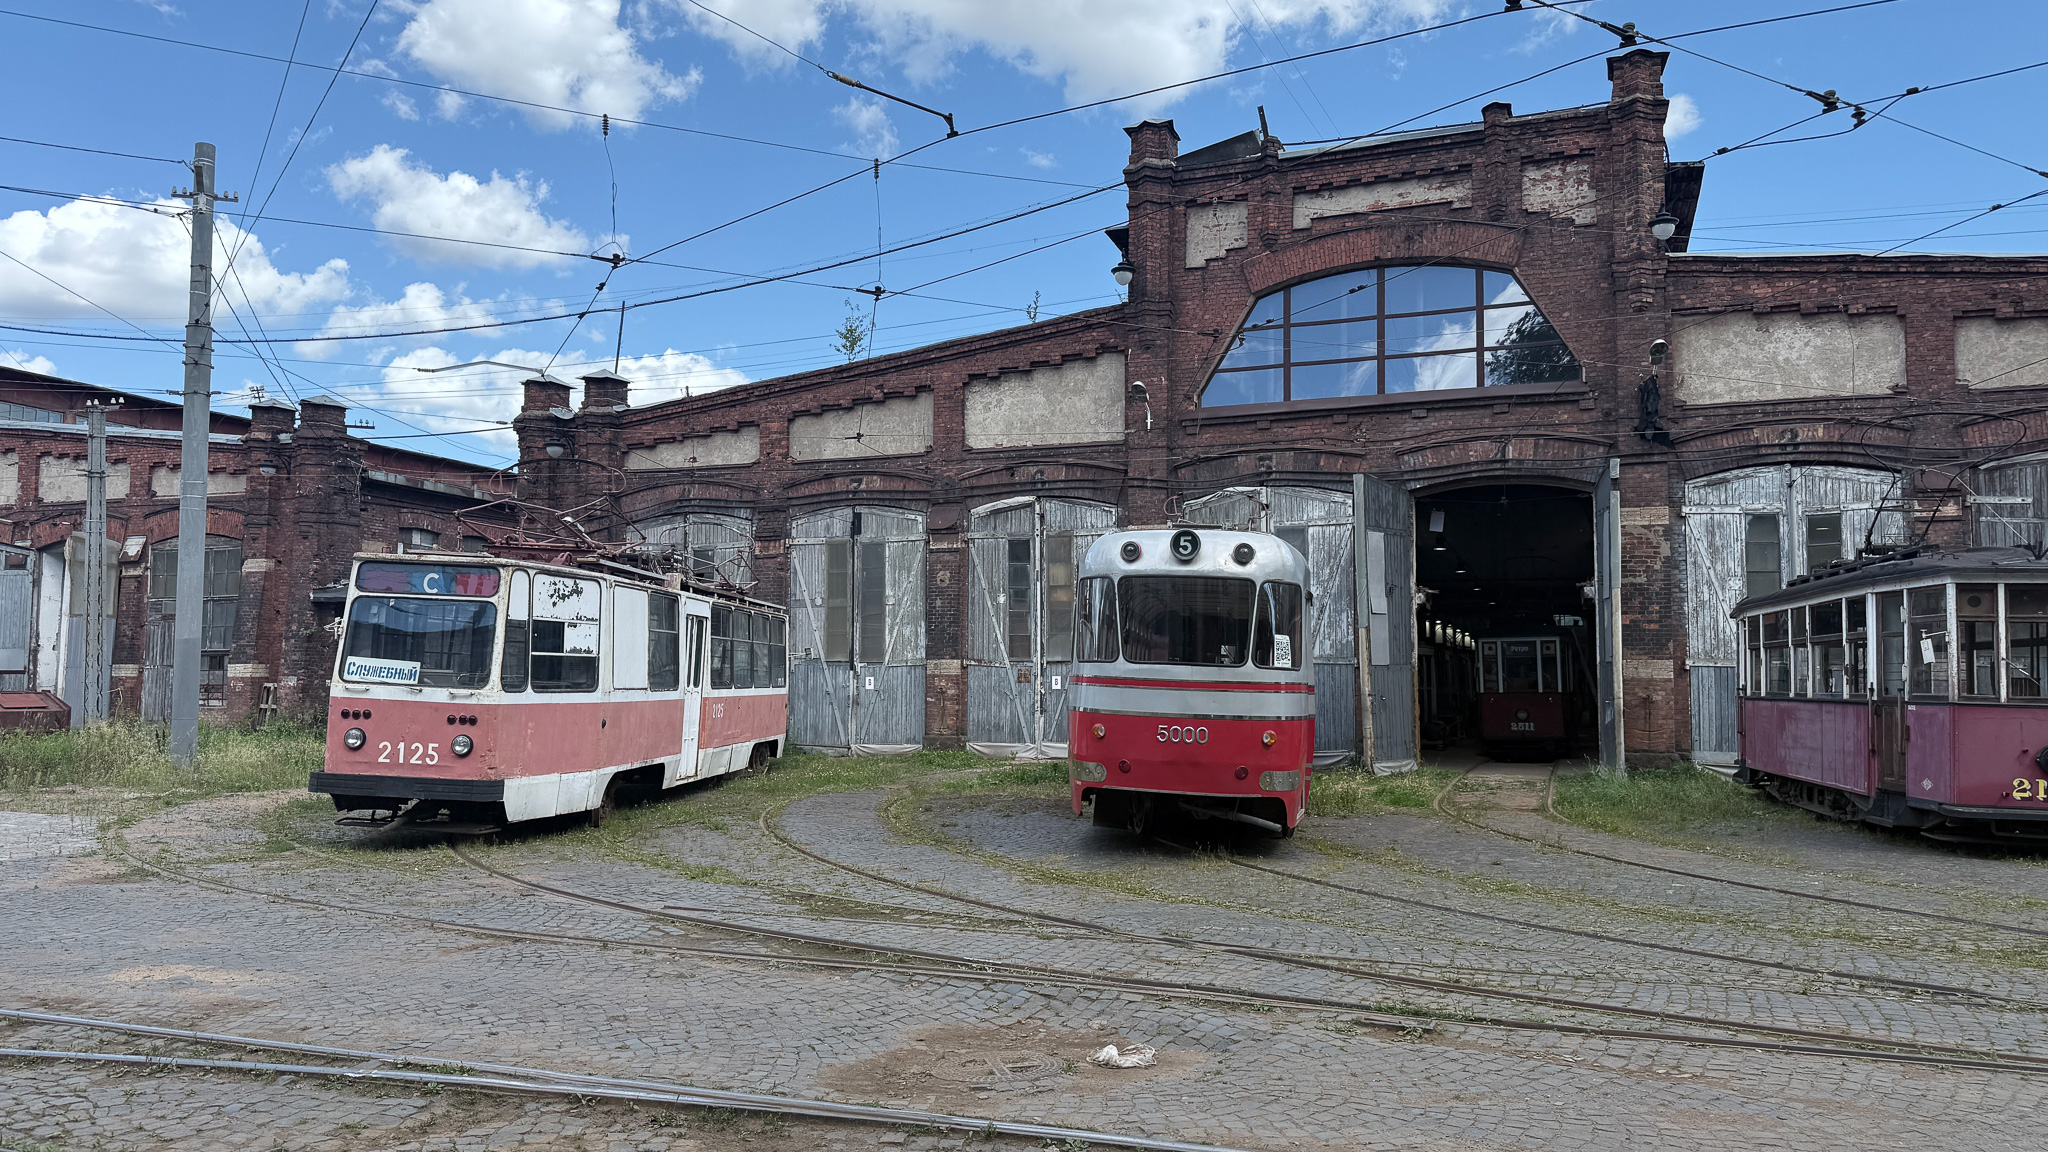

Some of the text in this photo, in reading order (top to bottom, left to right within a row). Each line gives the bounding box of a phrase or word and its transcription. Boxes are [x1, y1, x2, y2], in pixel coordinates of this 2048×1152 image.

[1179, 535, 1192, 555] 5
[712, 703, 724, 718] 2125
[1156, 724, 1209, 744] 5000
[1510, 722, 1535, 731] 2511
[377, 741, 439, 765] 2125
